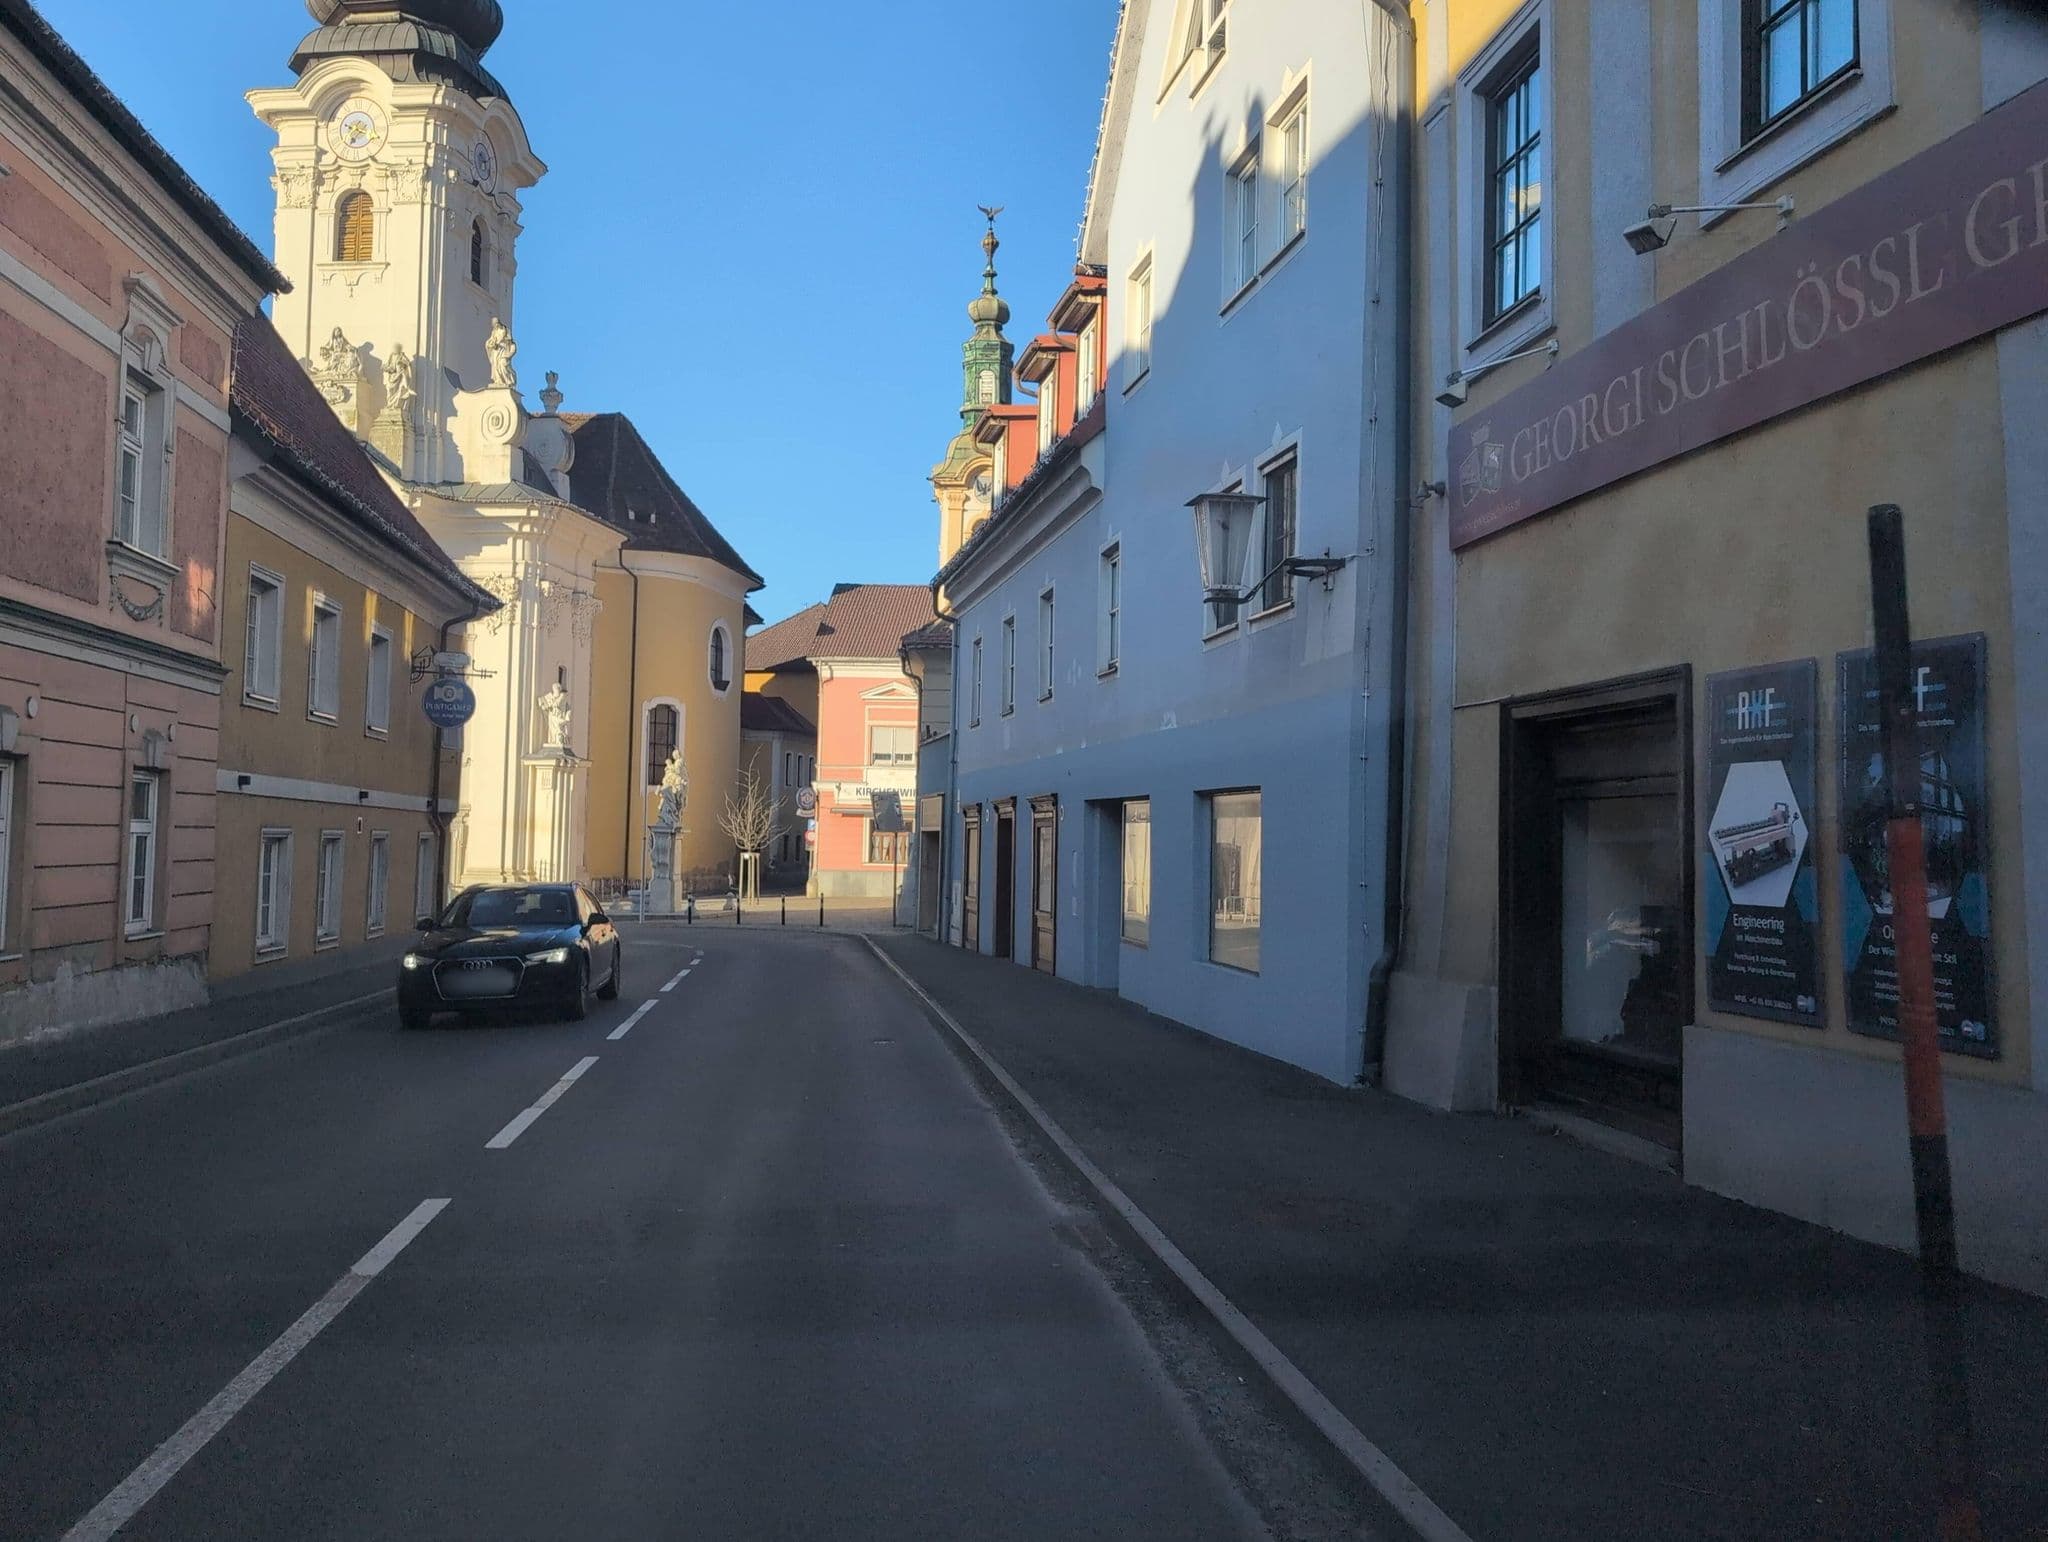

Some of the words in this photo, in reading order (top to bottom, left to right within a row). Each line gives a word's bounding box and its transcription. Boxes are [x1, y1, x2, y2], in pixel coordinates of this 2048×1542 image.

[1510, 365, 1646, 482] GEORGI
[1657, 221, 1944, 415] SCHLÖSSL
[424, 703, 472, 712] PUNTIGAMER
[1733, 913, 1785, 933] Engineering
